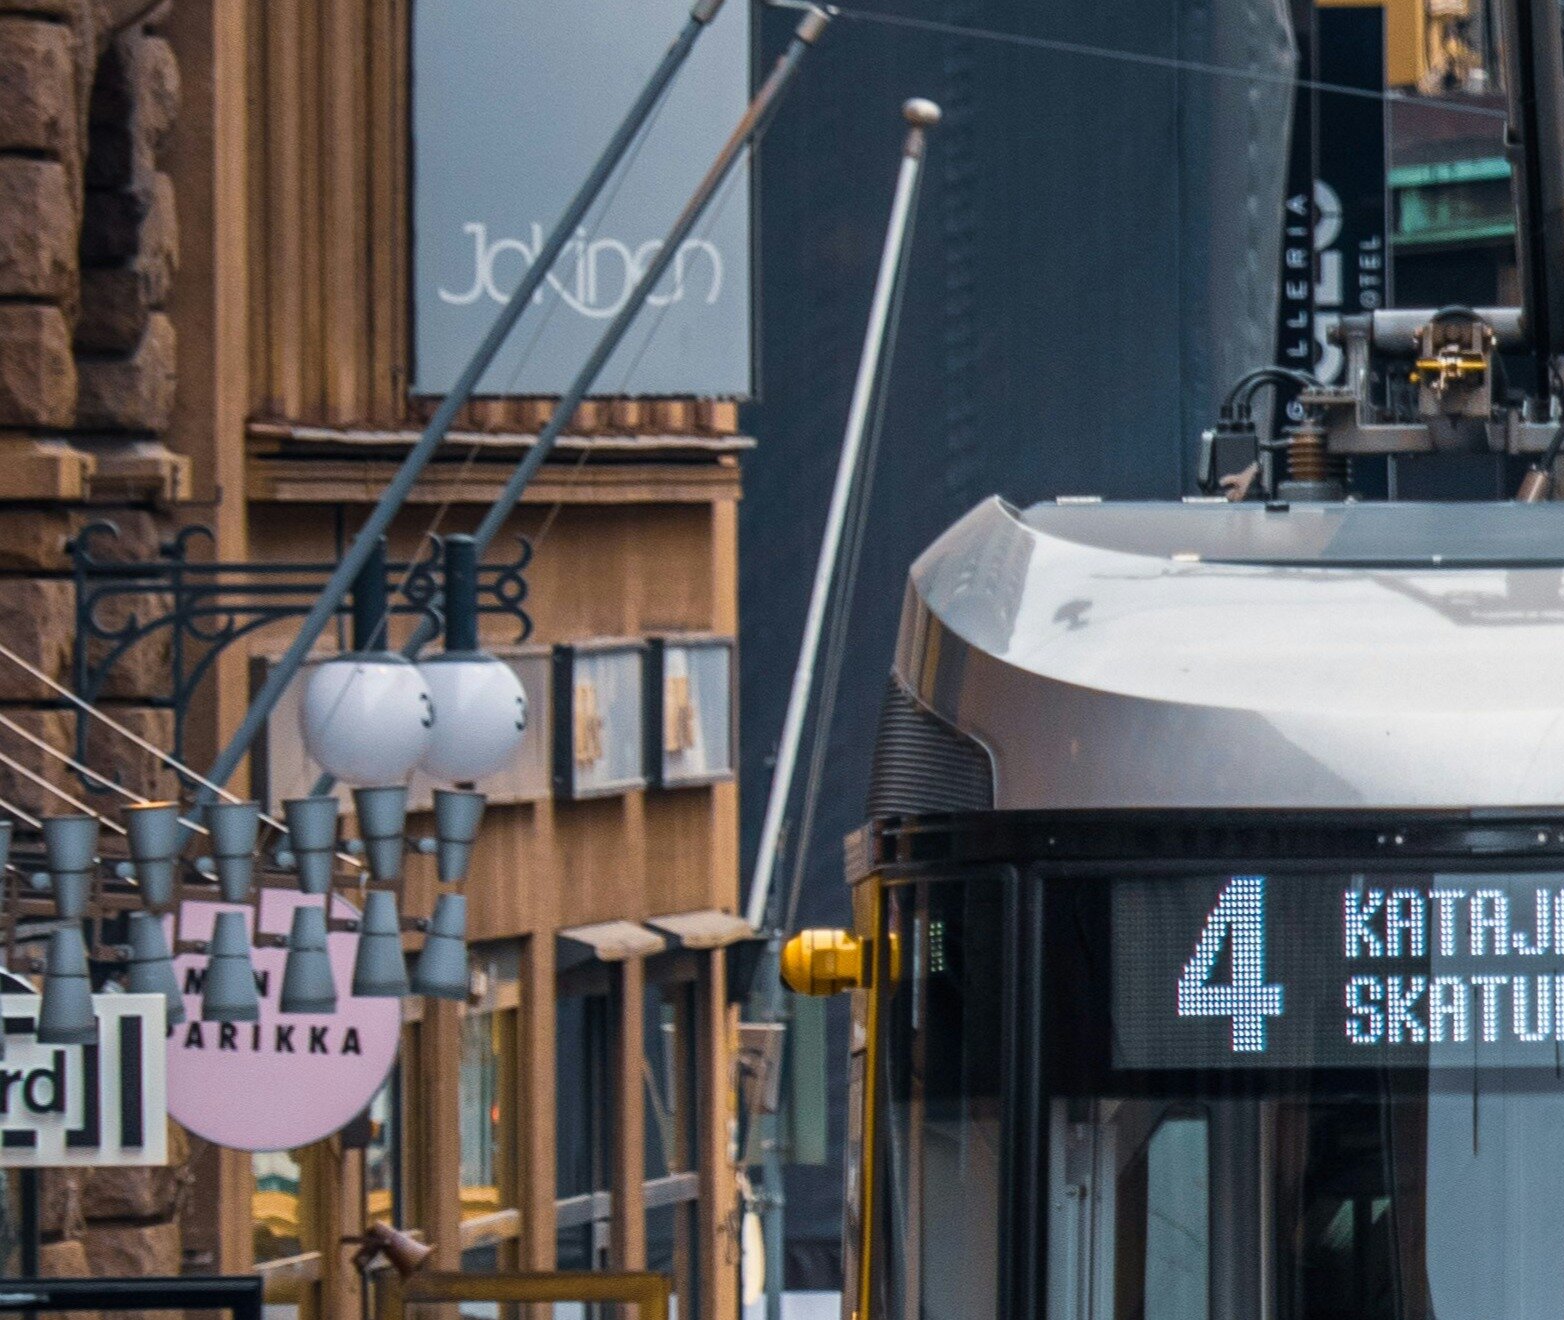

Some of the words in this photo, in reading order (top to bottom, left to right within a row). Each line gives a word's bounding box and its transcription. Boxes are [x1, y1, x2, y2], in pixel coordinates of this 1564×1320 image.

[1286, 194, 1309, 421] GLLERIA
[1358, 234, 1382, 309] OTEL
[1178, 875, 1283, 1053] 4
[167, 1021, 363, 1055] ARIKKA
